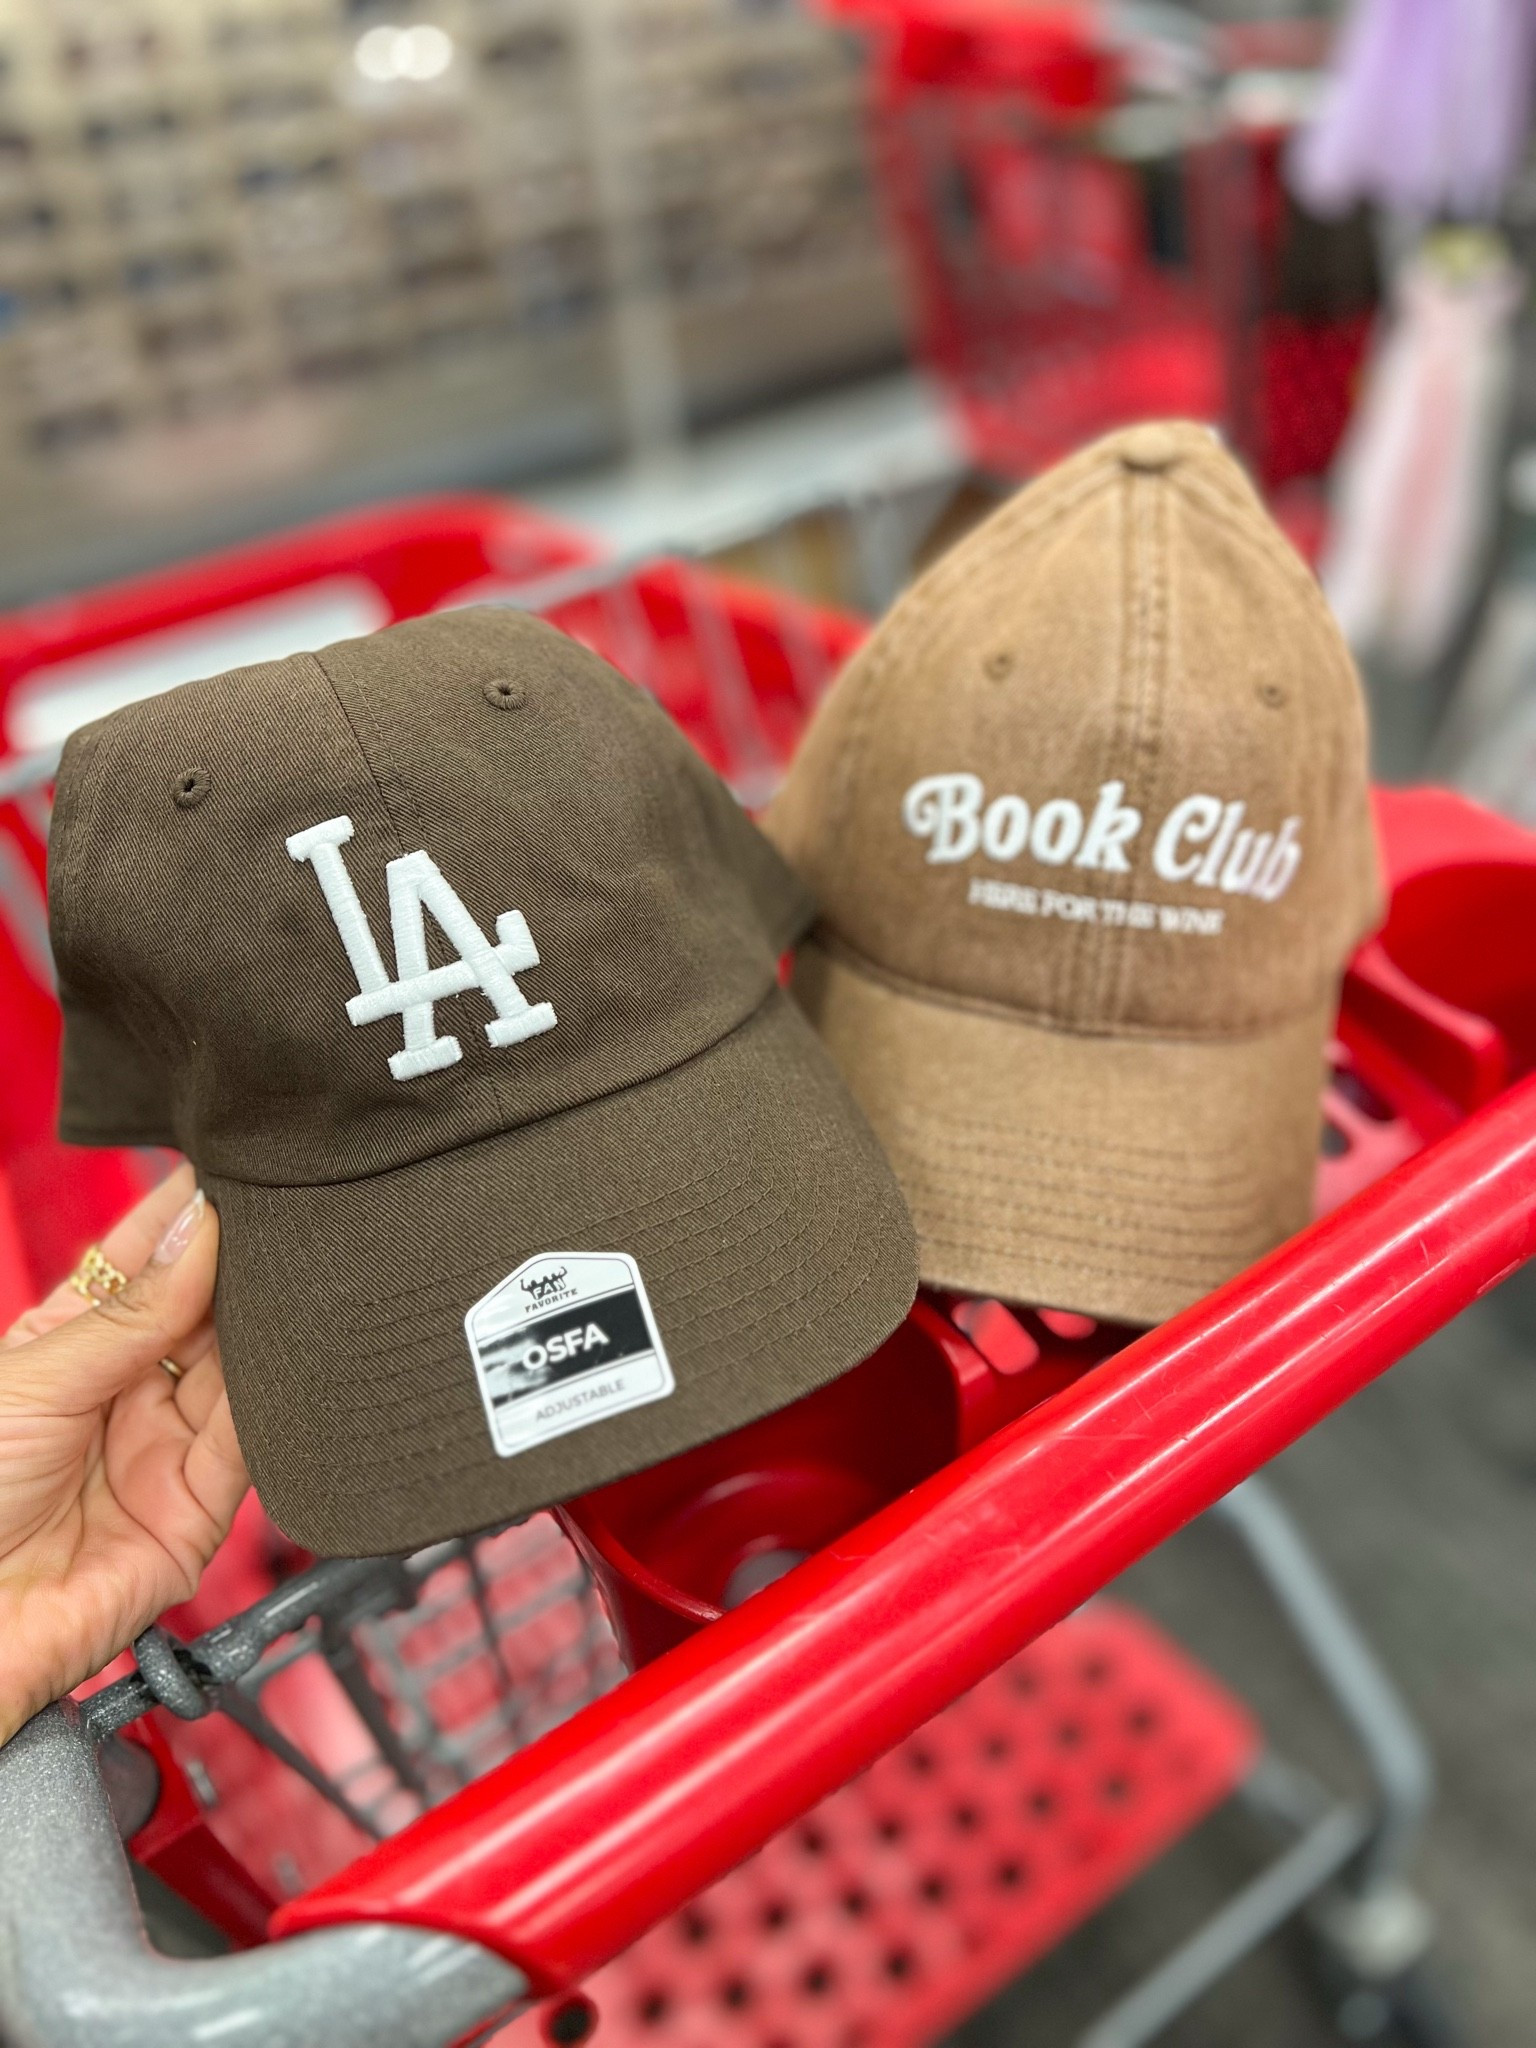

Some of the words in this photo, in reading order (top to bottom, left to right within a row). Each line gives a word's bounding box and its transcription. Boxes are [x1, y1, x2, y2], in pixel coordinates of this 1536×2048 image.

[902, 772, 1142, 873] Book
[1153, 795, 1302, 902] Club
[968, 878, 1038, 914] HERE
[1042, 891, 1099, 922] FOR
[1159, 906, 1225, 935] WINE
[286, 815, 558, 1081] LA
[525, 1288, 578, 1313] FAVORITE
[531, 1278, 567, 1300] FAN
[522, 1323, 610, 1370] OSFA
[535, 1379, 625, 1422] ADJUSTABLE
